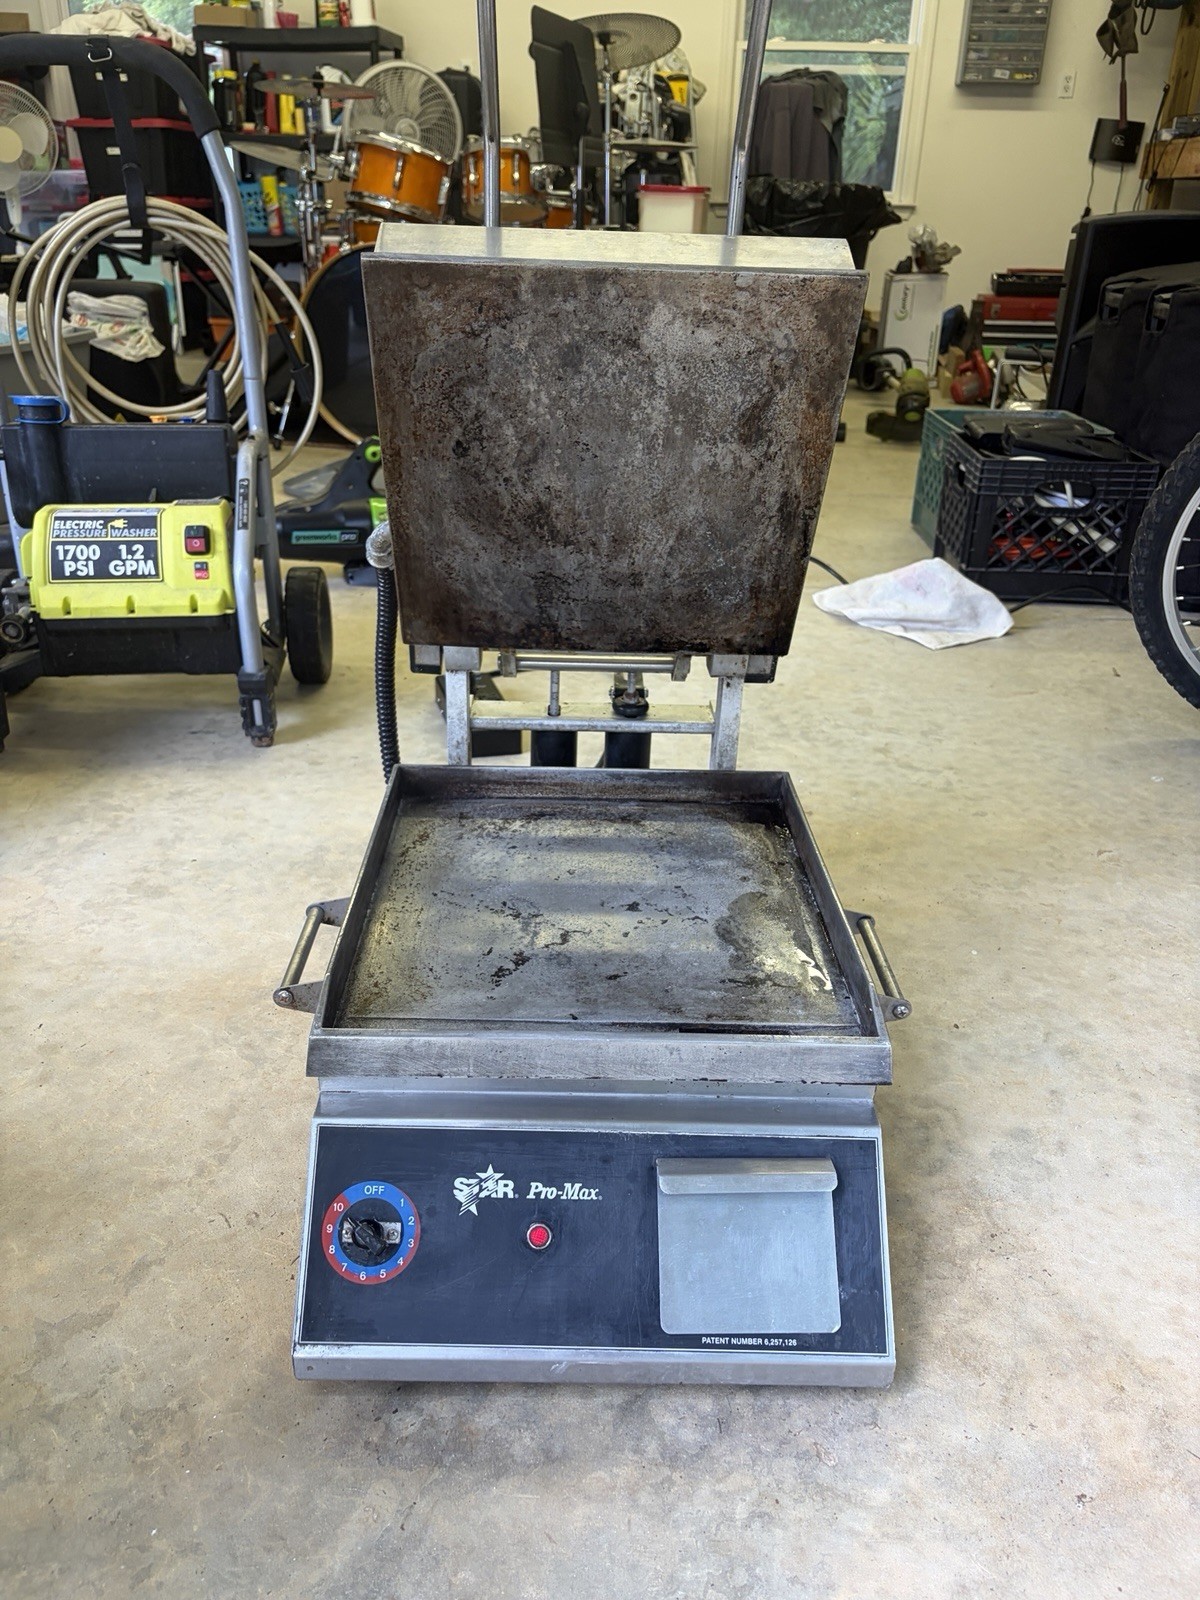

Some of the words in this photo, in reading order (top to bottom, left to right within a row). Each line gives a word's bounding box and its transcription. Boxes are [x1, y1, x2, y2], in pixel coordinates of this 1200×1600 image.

[53, 520, 104, 529] ELECTRIC
[53, 529, 107, 538] PRESSURE
[111, 528, 157, 537] WASHER
[55, 544, 100, 560] 1700
[118, 544, 144, 560] 1.2
[63, 560, 94, 576] PSI
[108, 560, 156, 576] GPM
[364, 1185, 385, 1195] OFF
[526, 1181, 599, 1201] Pro-Max
[333, 1202, 344, 1212] 10
[400, 1198, 404, 1207] 1
[408, 1216, 415, 1226] 2
[326, 1224, 333, 1233] 9
[408, 1238, 414, 1248] 3
[328, 1245, 335, 1254] 8
[397, 1256, 404, 1266] 4
[341, 1262, 348, 1271] 7
[359, 1271, 366, 1280] 6
[379, 1269, 386, 1278] 5
[701, 1336, 729, 1345] PATENT
[731, 1337, 762, 1346] NUMBER
[763, 1338, 798, 1347] 6,257,126
